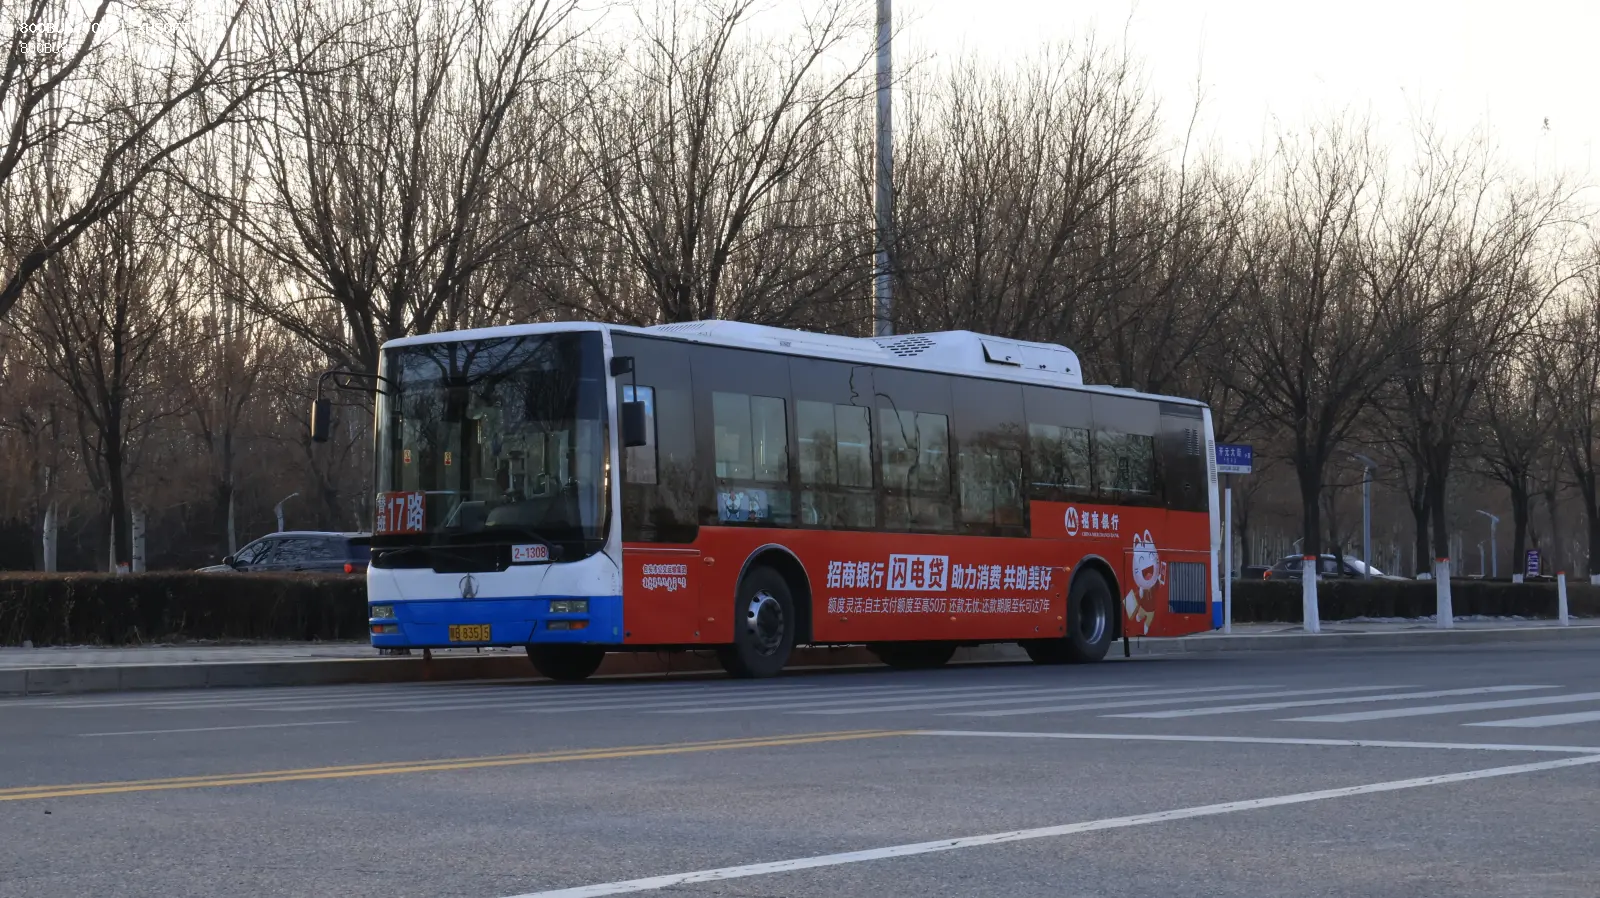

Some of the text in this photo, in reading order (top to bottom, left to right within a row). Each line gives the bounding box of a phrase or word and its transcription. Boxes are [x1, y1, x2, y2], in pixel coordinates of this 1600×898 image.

[387, 491, 424, 532] 17路
[1081, 510, 1119, 531] 招商银行
[514, 546, 548, 560] 2-1308
[827, 557, 1053, 591] 招商银行 闪电贷 助力消费 共助美好
